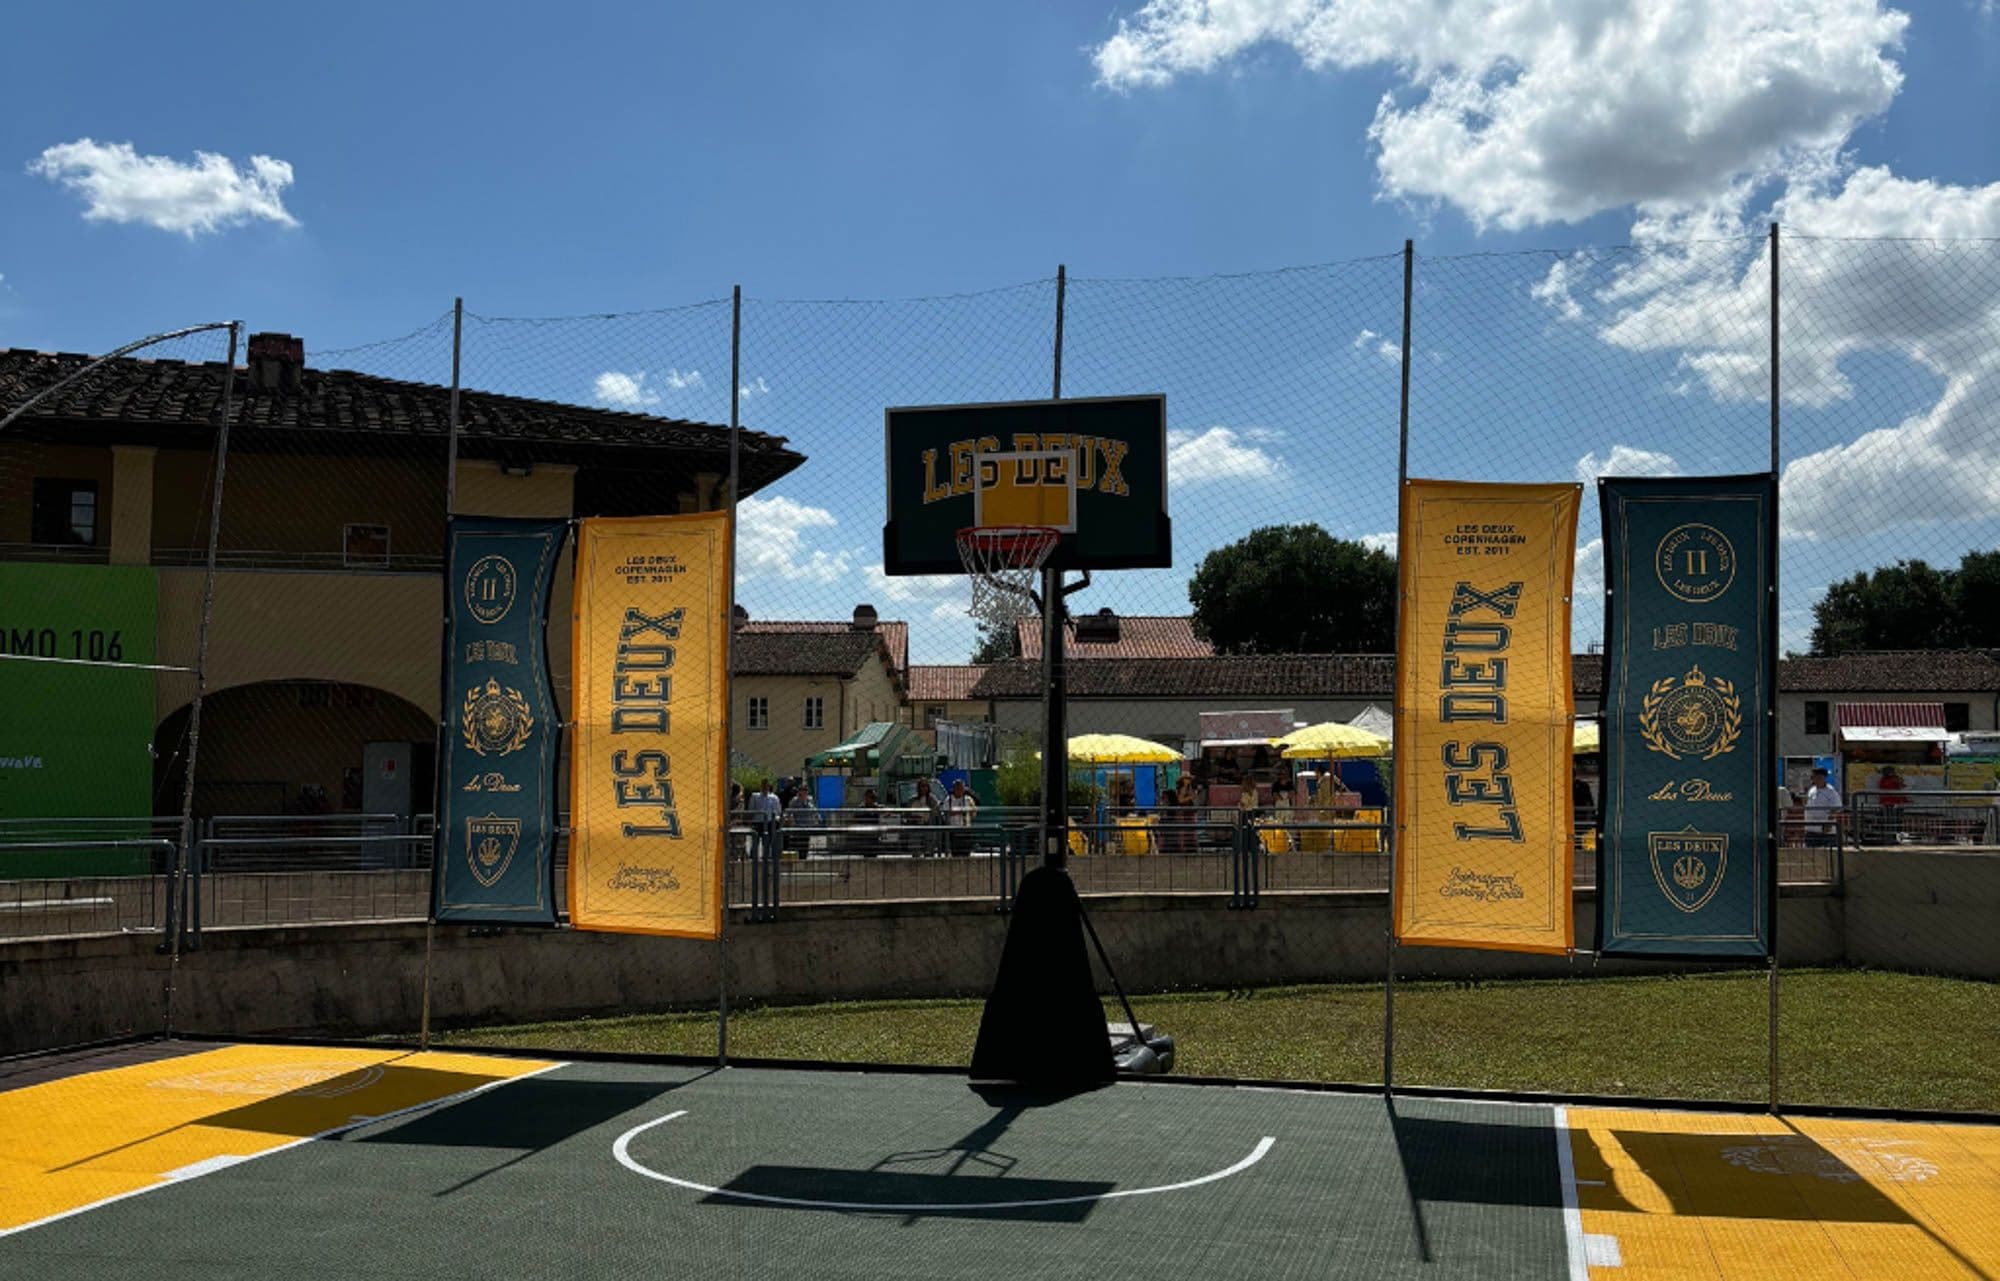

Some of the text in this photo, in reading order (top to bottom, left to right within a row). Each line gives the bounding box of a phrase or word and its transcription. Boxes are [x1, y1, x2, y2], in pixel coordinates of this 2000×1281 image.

[921, 433, 1130, 504] LES DEUX
[1444, 535, 1527, 544] COPENHAGEN
[1456, 525, 1515, 534] LES DEUX
[626, 556, 645, 565] LES
[1485, 547, 1509, 555] 2011
[72, 630, 122, 660] 106
[1652, 622, 1739, 651] LES DEUX
[1440, 581, 1524, 725] DEUX
[610, 607, 687, 735] DEUX
[611, 749, 684, 840] LES
[1442, 742, 1525, 844] LES
[1657, 841, 1720, 852] LES DEUX
